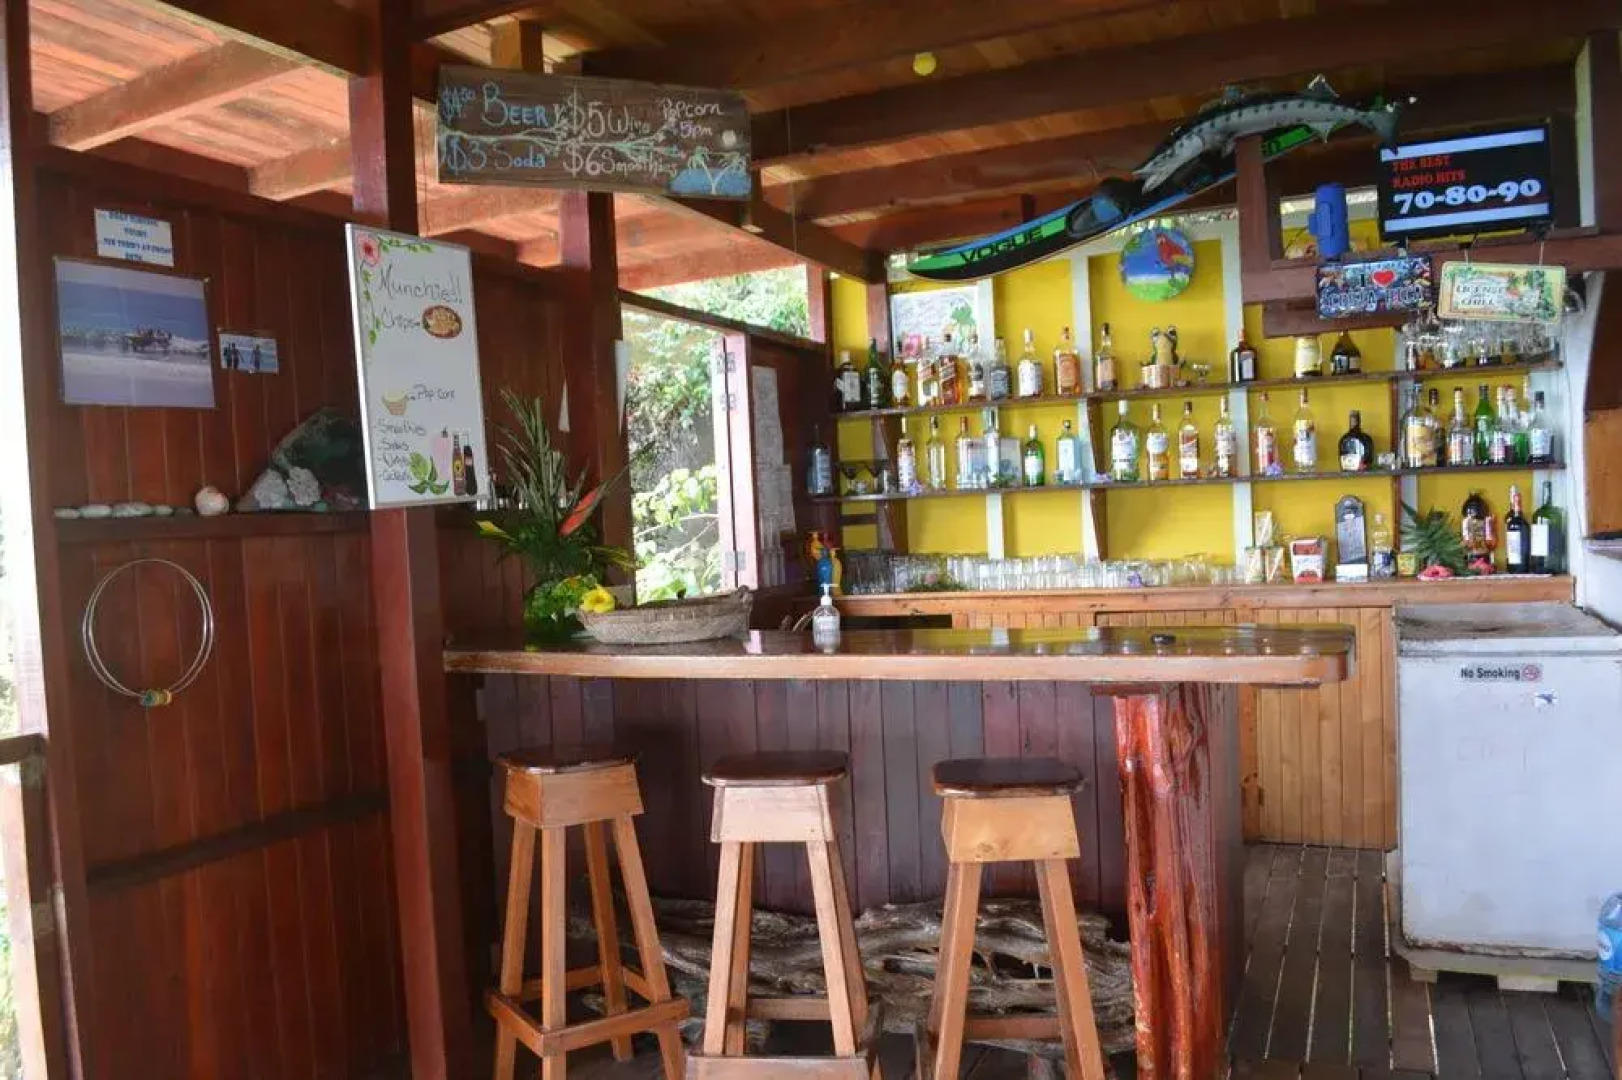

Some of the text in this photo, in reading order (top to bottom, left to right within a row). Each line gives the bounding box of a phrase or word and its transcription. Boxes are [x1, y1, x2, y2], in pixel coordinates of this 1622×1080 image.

[482, 82, 549, 128] BEER
[492, 143, 547, 170] Soda
[562, 138, 601, 178] $6
[1392, 155, 1451, 171] THE BEST
[1391, 169, 1466, 188] RADIO HITS
[1393, 179, 1541, 214] 70-80-90
[960, 227, 1044, 265] VOGUE
[1460, 667, 1521, 681] No Smoking
